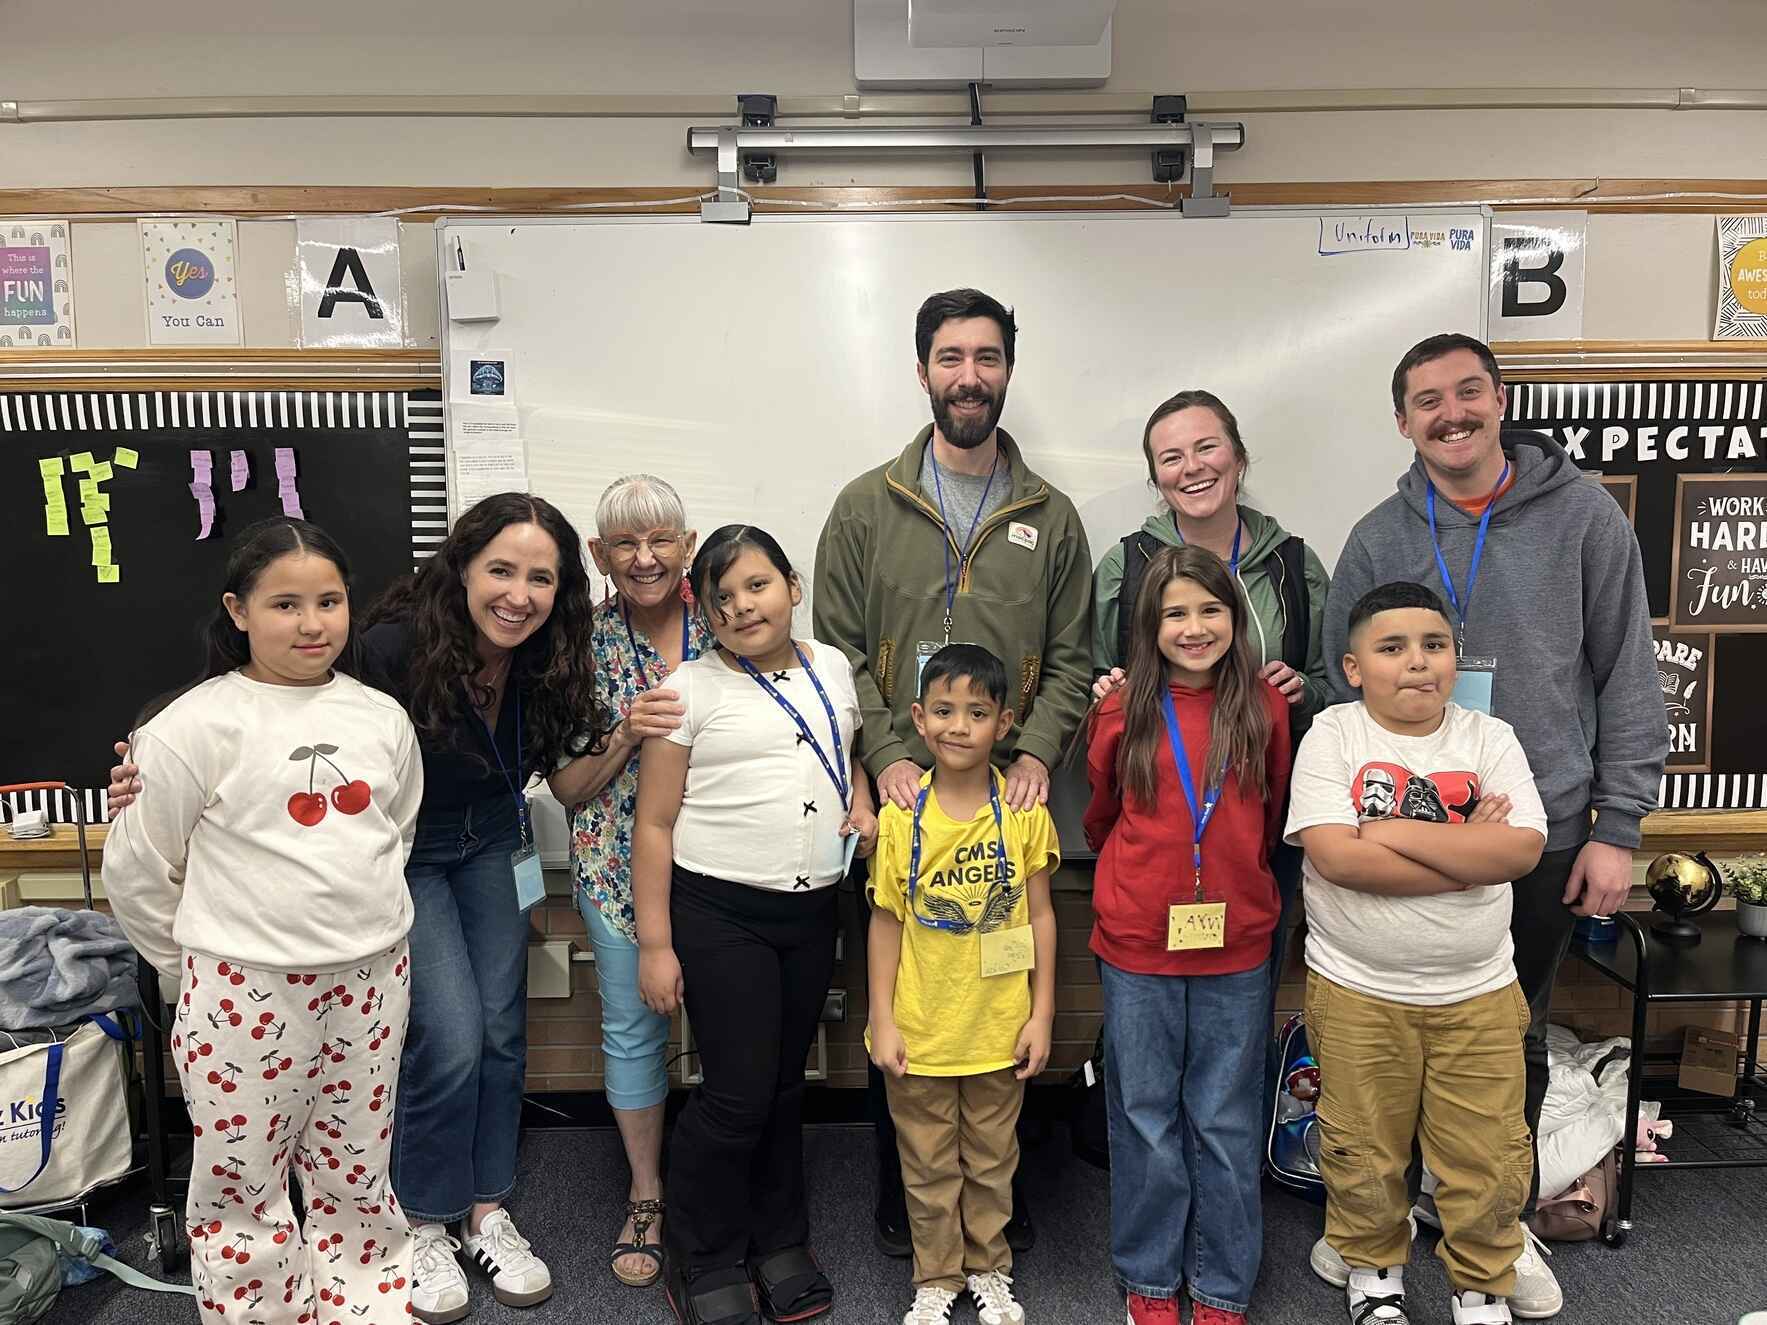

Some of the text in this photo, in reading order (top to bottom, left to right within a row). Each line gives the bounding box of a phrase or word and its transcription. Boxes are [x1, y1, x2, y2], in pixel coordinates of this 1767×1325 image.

[1335, 218, 1401, 244] Uniform
[1449, 228, 1474, 241] PURA
[1450, 239, 1471, 250] VIDA
[7, 253, 26, 262] This
[1, 265, 44, 274] where the
[170, 260, 209, 286] Yes
[1501, 237, 1567, 318] B
[3, 280, 44, 303] FUN
[317, 247, 383, 318] A
[3, 306, 47, 319] happens
[162, 315, 225, 328] You Can
[1533, 425, 1767, 462] XPECTA
[1708, 496, 1765, 517] WORK
[1727, 559, 1738, 570] &
[1687, 566, 1755, 616] Fun
[954, 840, 998, 865] CMS
[929, 861, 1016, 888] ANGELS
[11, 1120, 66, 1142] tutorg!
